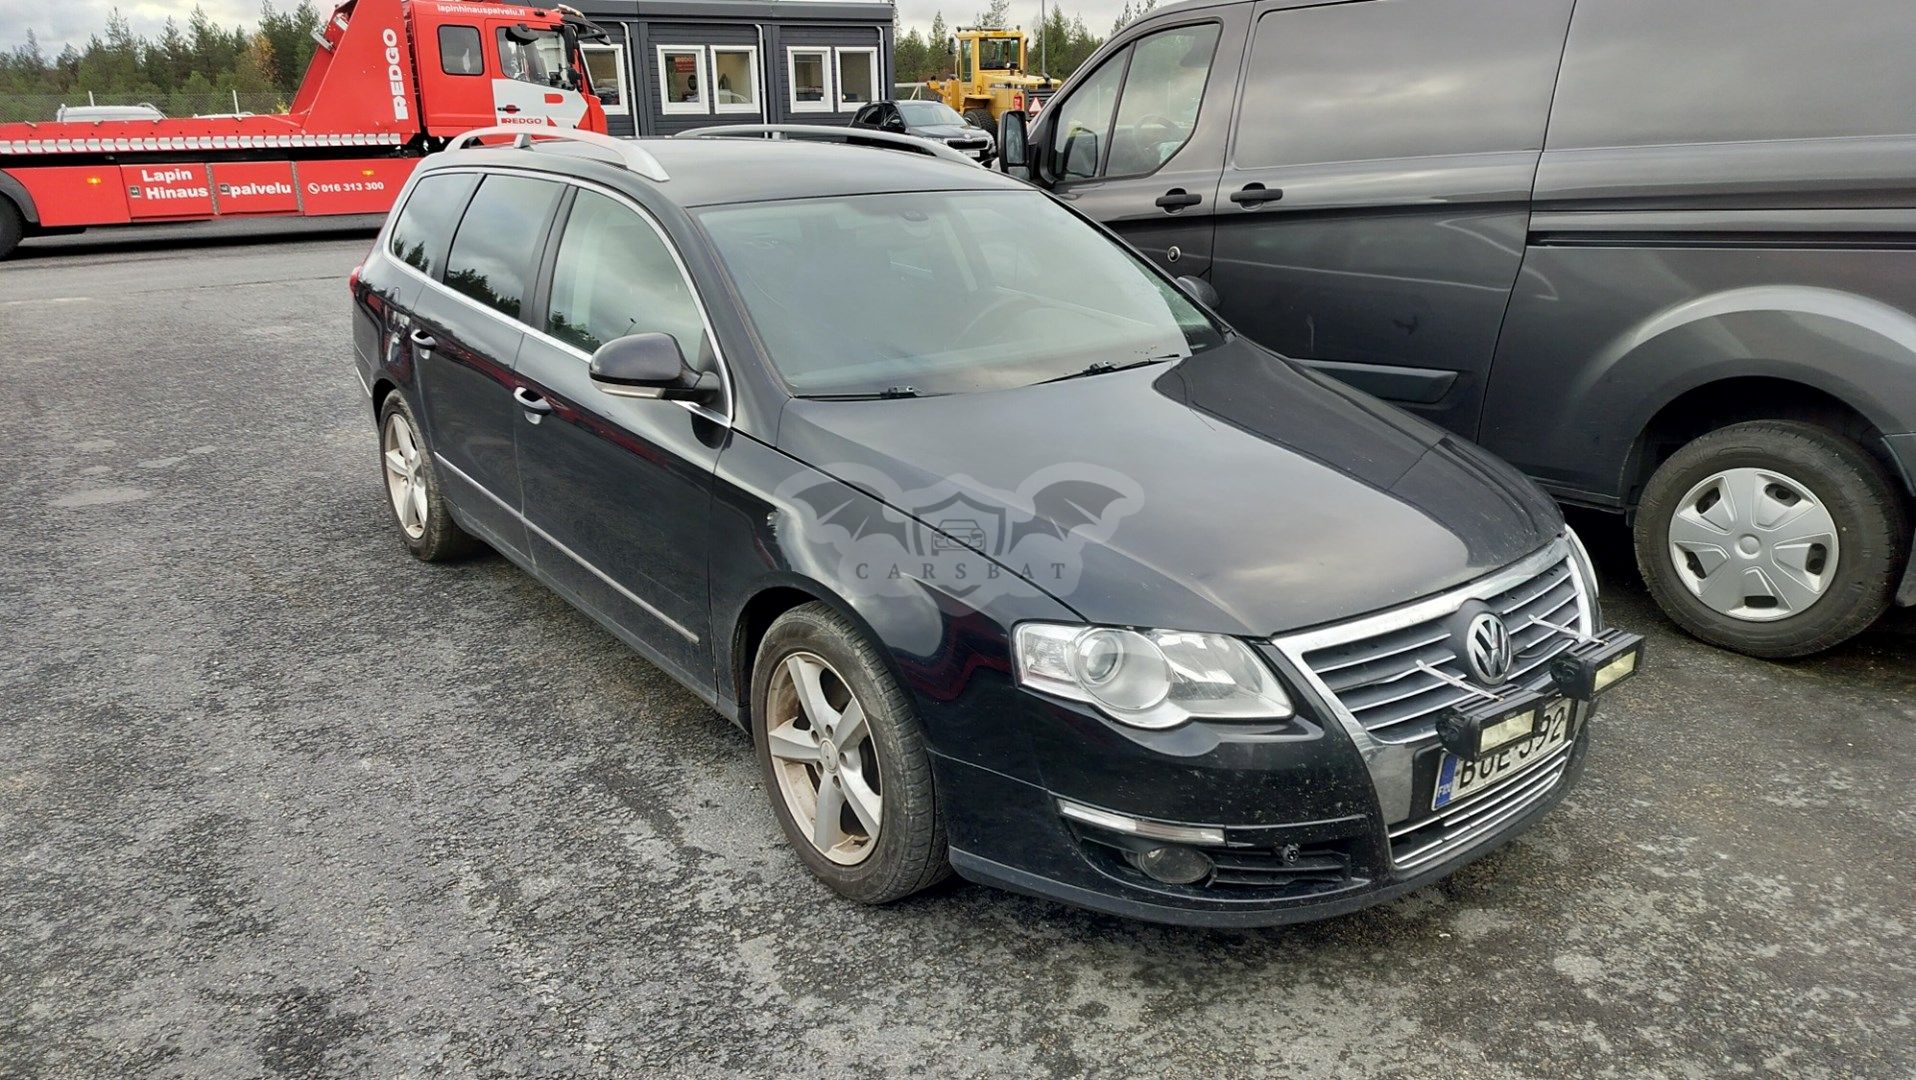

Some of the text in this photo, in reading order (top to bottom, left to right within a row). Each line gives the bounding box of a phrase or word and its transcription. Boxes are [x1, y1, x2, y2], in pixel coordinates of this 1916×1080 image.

[437, 4, 525, 16] lapinhinauspalvelu.fi
[382, 28, 409, 120] REDGO
[501, 117, 542, 125] REDGO
[141, 168, 192, 184] Lapin
[145, 182, 292, 200] Hinaus palvelu
[321, 181, 385, 193] 016 313 300
